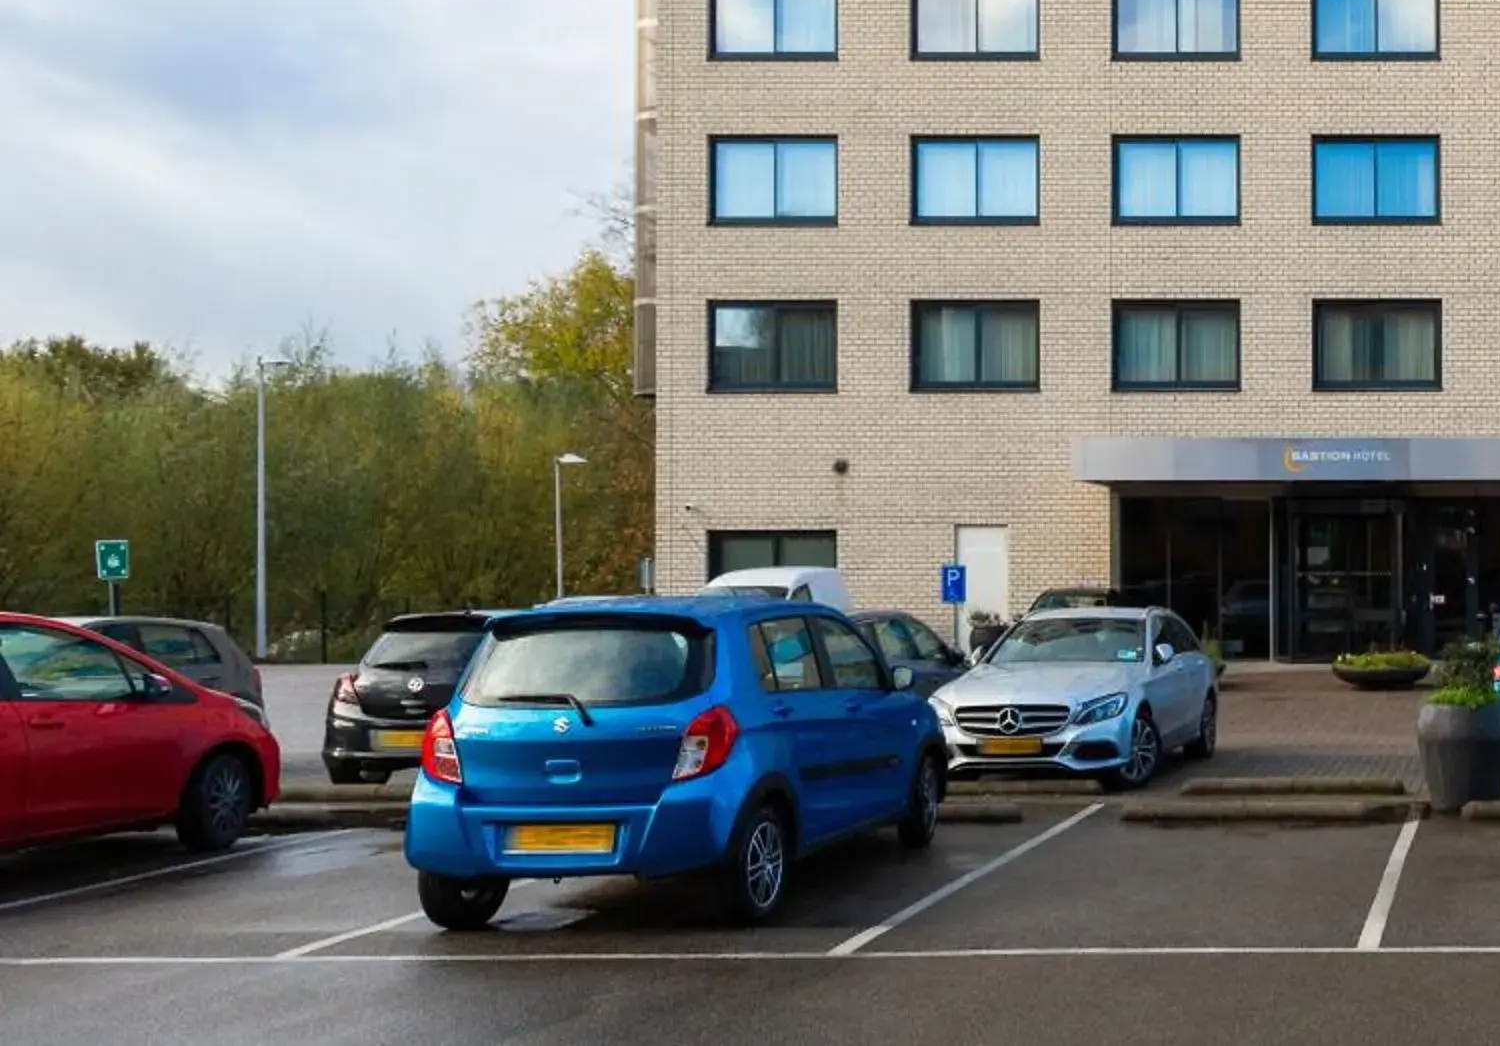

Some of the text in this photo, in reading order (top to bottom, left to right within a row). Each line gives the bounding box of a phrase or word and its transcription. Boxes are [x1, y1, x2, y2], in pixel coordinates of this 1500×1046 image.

[1292, 451, 1391, 461] BASTION HOTEL
[948, 569, 960, 586] P
